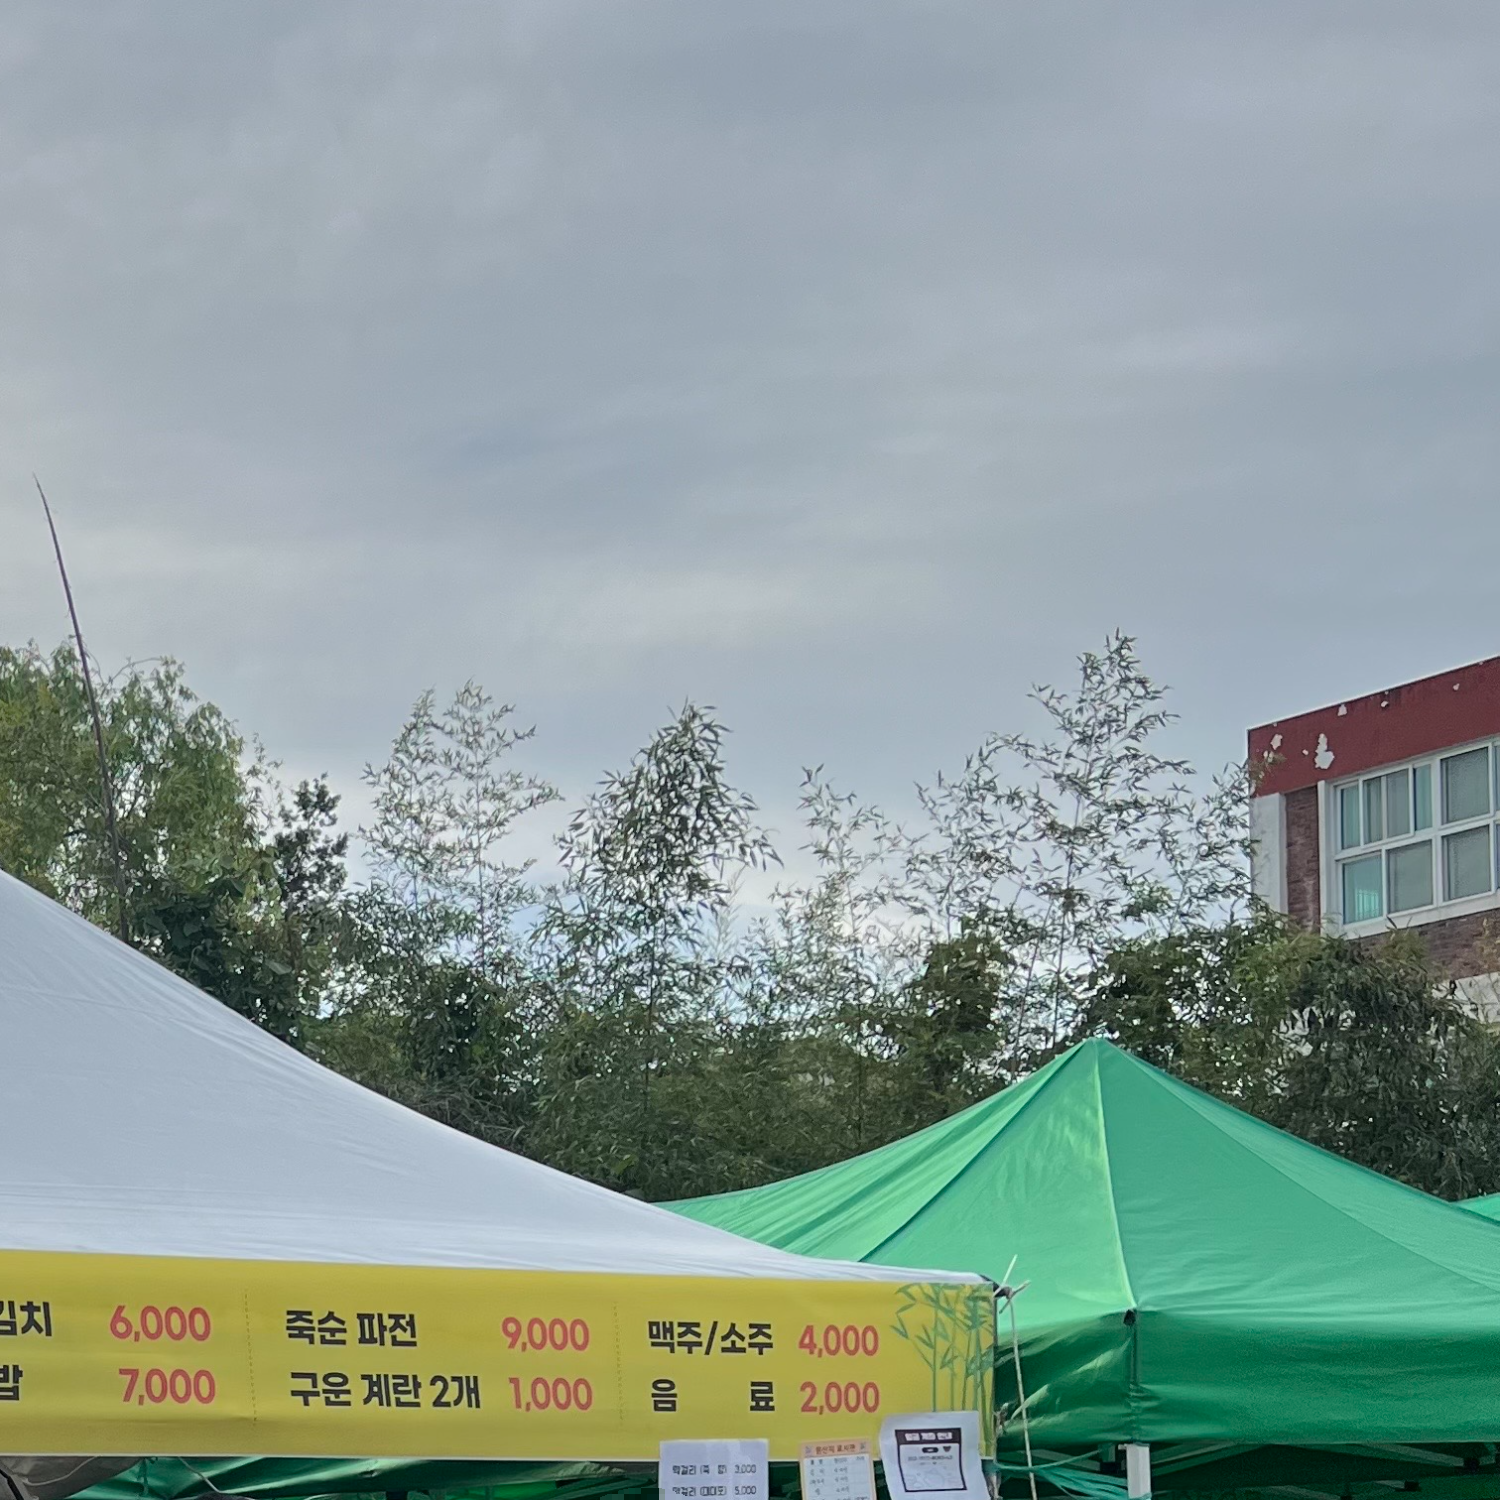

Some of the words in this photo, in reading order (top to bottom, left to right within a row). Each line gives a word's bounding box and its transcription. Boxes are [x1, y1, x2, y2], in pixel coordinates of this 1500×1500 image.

[109, 1305, 211, 1343] 6,000
[285, 1310, 347, 1345] 죽순
[356, 1312, 417, 1347] 파전
[502, 1316, 590, 1352] 9,000
[648, 1320, 773, 1356] 맥주/소주
[798, 1324, 879, 1358] 4,000
[118, 1368, 216, 1406] 7,000
[290, 1371, 351, 1407] 구운
[360, 1373, 422, 1408] 계란
[429, 1374, 481, 1409] 2개
[508, 1376, 592, 1412] 1,000
[651, 1378, 678, 1412] 음
[749, 1380, 775, 1412] 료
[800, 1380, 880, 1415] 2,000
